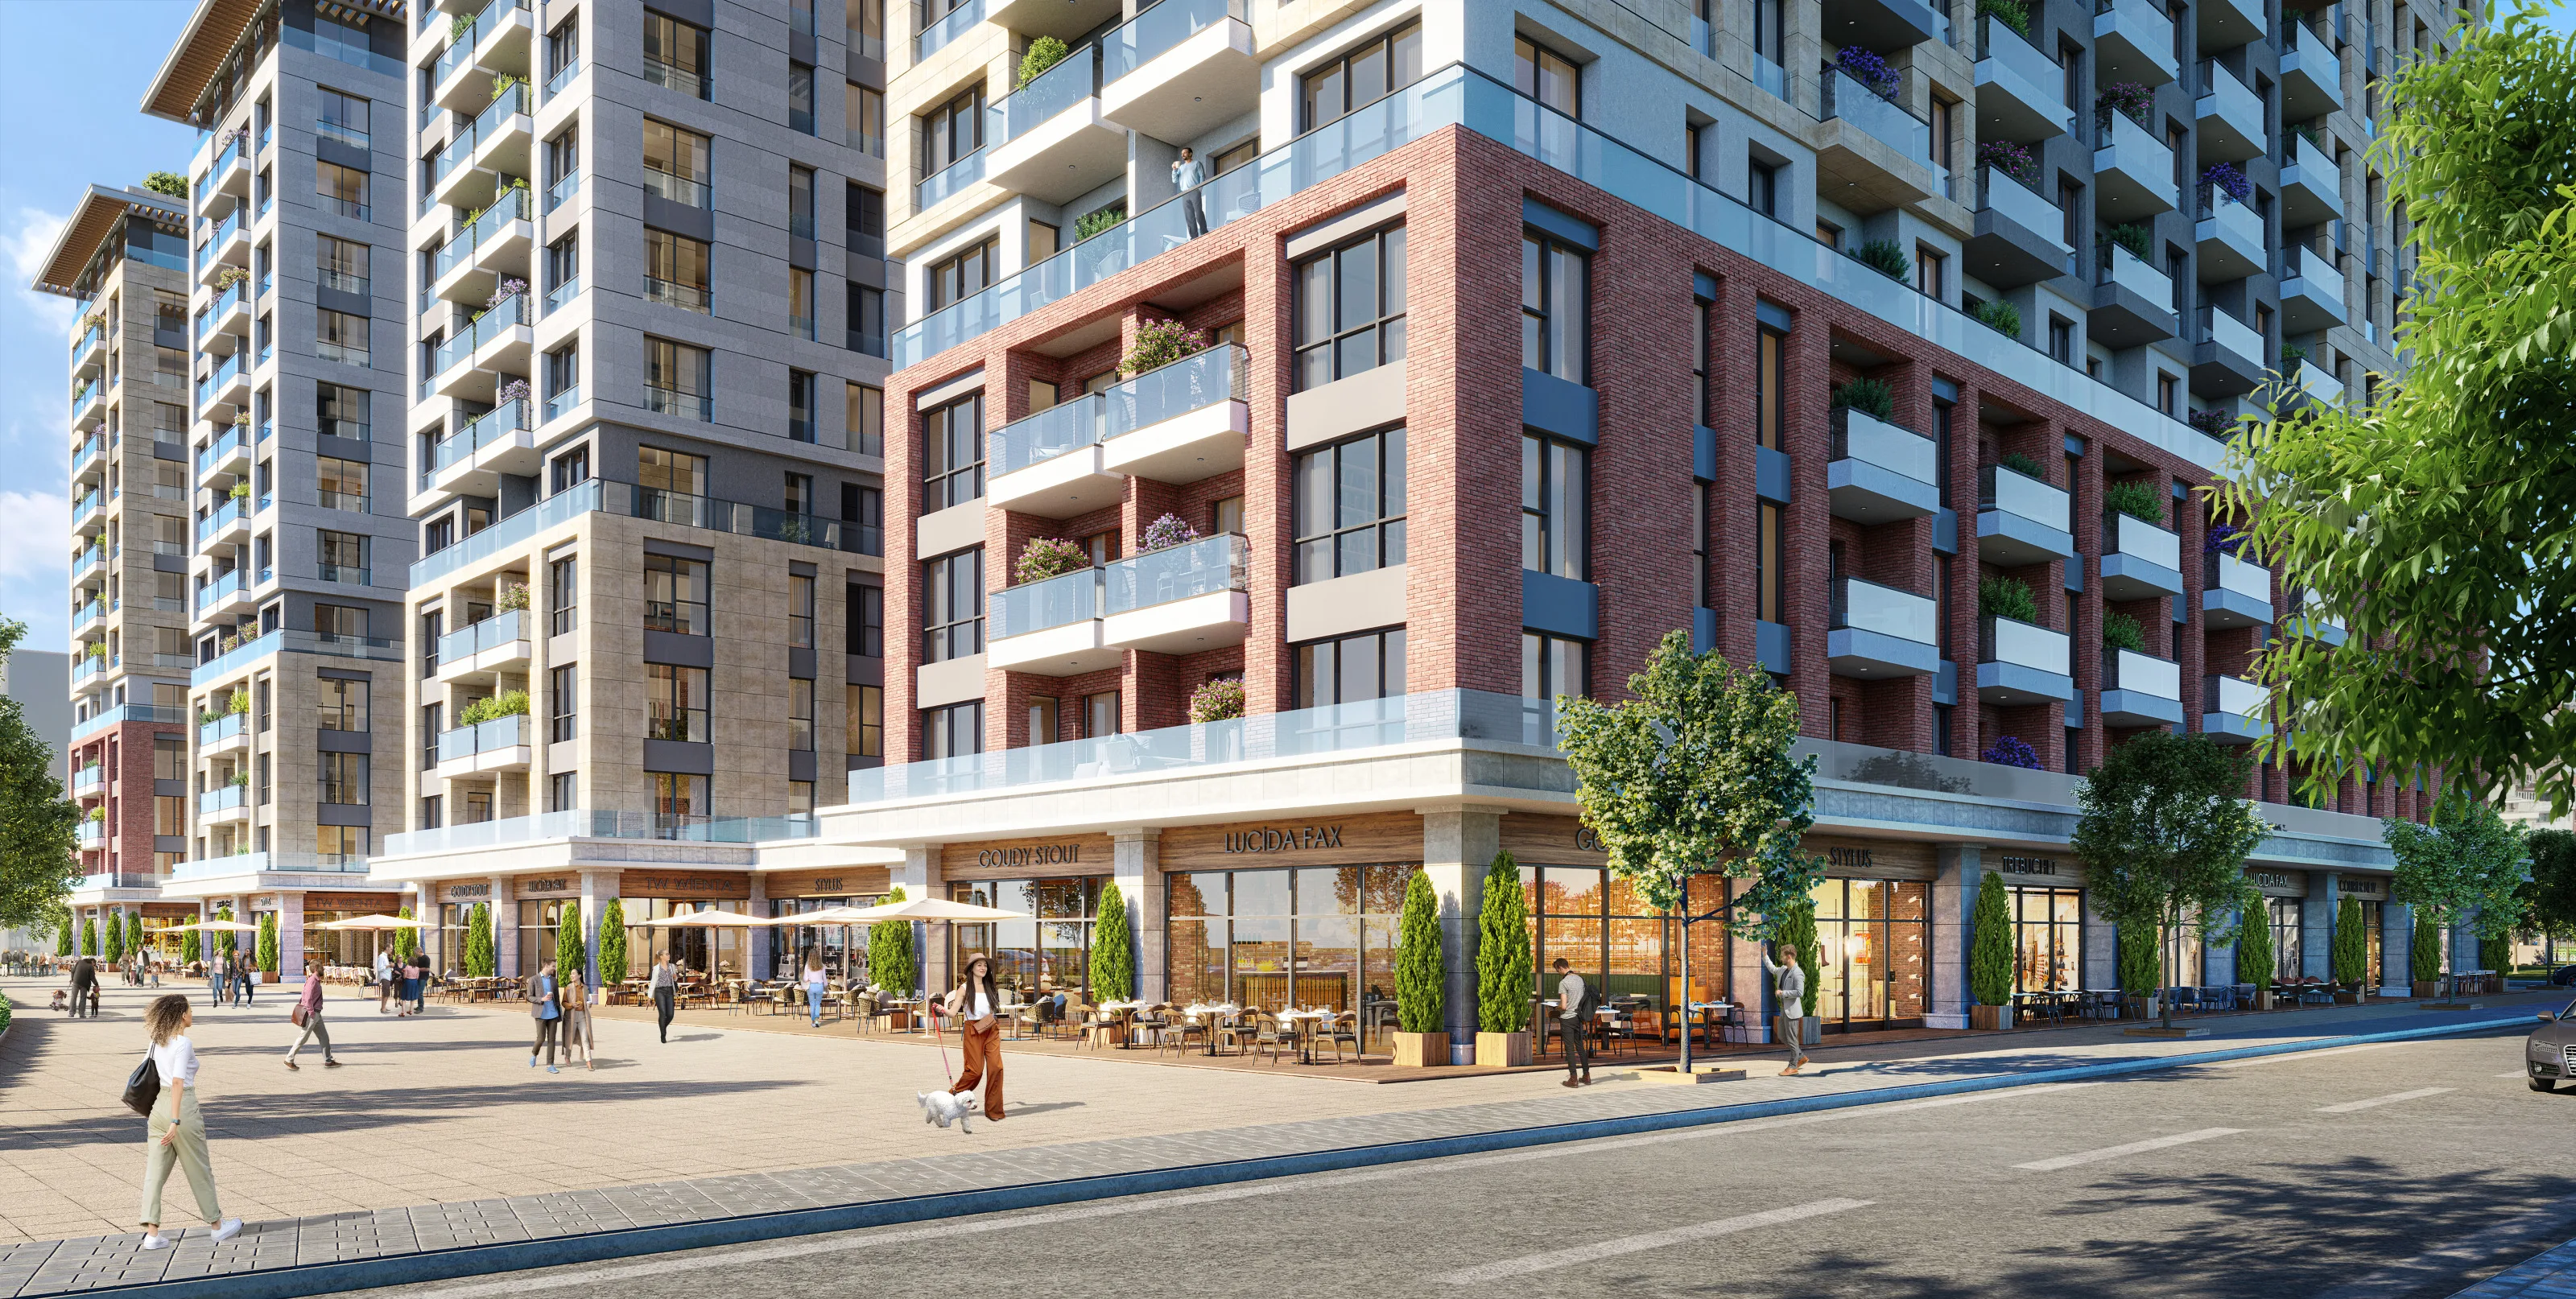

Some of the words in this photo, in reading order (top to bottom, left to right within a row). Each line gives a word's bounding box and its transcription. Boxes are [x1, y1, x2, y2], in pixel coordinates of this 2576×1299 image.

[1303, 826, 1342, 849] FAX
[978, 847, 1031, 868] GOUDY
[1034, 844, 1080, 864] STOUT
[1830, 847, 1873, 868] STYLUS
[646, 876, 670, 890] TW
[815, 877, 844, 892] STYLUS
[2276, 874, 2288, 888] FAX
[451, 886, 469, 897] GOUDY
[471, 884, 488, 897] STOUT
